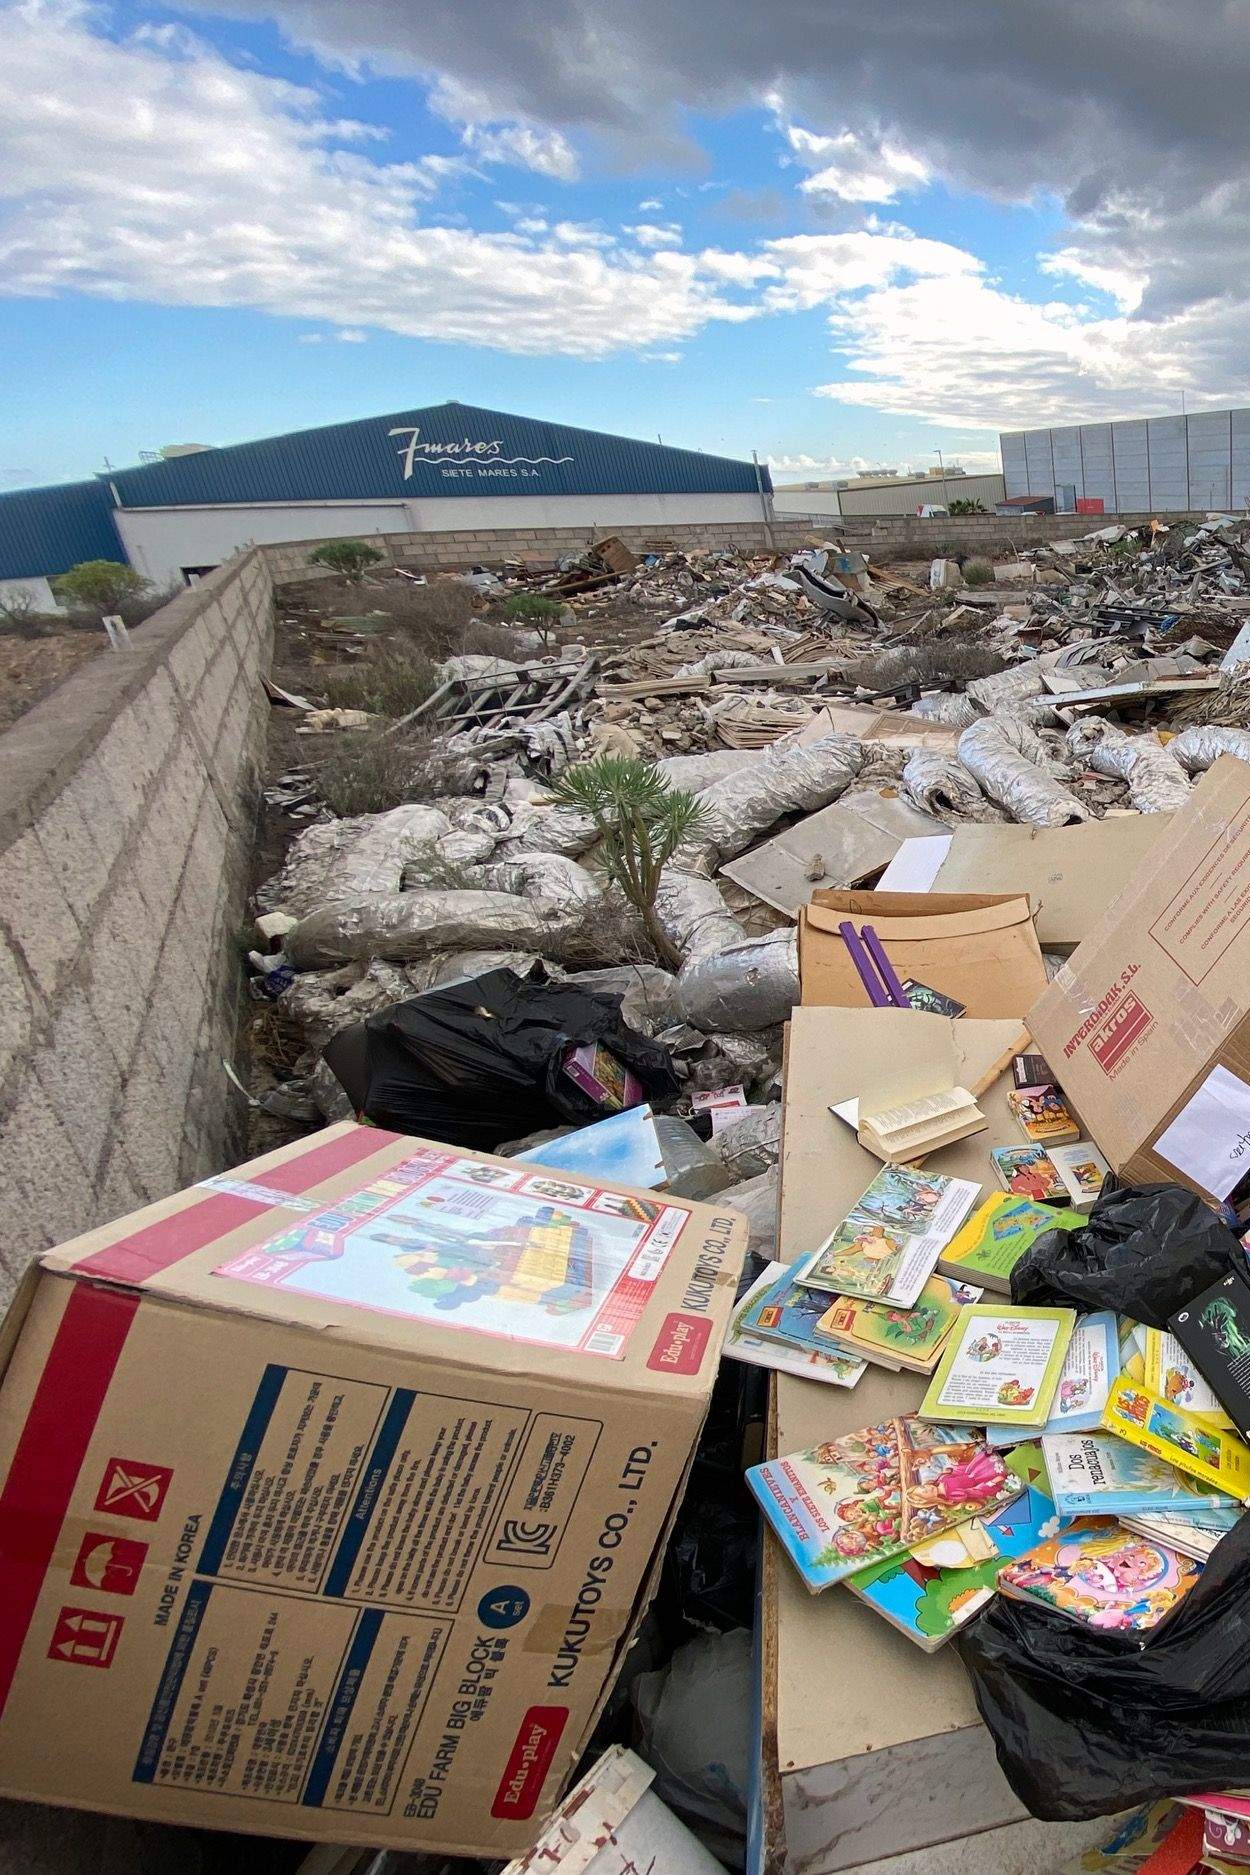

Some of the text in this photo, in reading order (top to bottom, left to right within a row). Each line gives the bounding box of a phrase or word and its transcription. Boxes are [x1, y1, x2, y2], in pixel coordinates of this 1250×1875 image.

[442, 469, 473, 478] SIETE
[478, 469, 517, 478] MARES
[1163, 895, 1191, 932] CONFORME
[1188, 884, 1199, 899] AUX
[1221, 842, 1232, 853] DE
[1178, 913, 1203, 944] COMPLIES
[1201, 897, 1215, 914] WITH
[1212, 874, 1232, 899] SAFETY
[1199, 913, 1229, 950] CONFORME
[1229, 896, 1242, 911] LAS
[1090, 997, 1137, 1052] akros
[1109, 1020, 1159, 1082] Made in Spain
[681, 1254, 722, 1312] KUKUTOYS
[1069, 1454, 1085, 1471] Dos
[1081, 1439, 1106, 1485] renacuajos
[354, 1467, 383, 1519] Attentions
[761, 1467, 810, 1541] BLANCANIEVES
[781, 1461, 830, 1532] LOS SIETE ENANITOS
[789, 1496, 798, 1504] Y
[154, 1514, 202, 1626] MADE IN KOREA
[547, 1556, 614, 1687] KUKUTOYS
[618, 1440, 658, 1490] LTD.
[490, 1600, 509, 1615] A
[512, 1600, 525, 1617] set
[417, 1636, 495, 1819] EDU FARM BIG BLOCK
